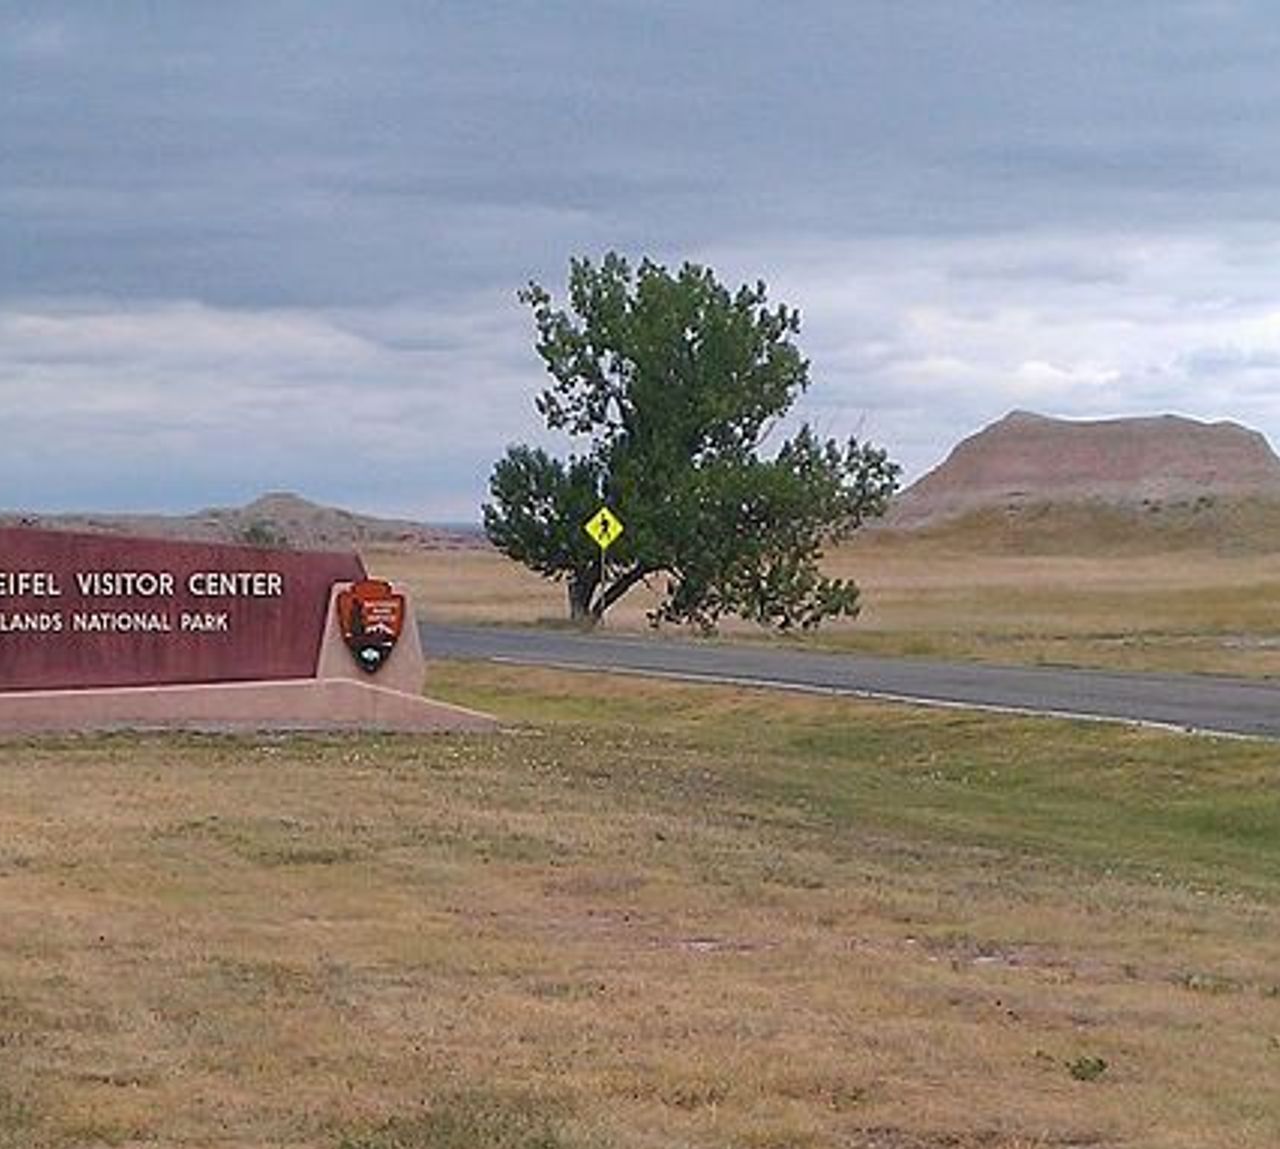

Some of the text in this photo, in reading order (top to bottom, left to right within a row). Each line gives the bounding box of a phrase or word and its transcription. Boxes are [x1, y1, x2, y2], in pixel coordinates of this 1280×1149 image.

[76, 572, 174, 596] VISITOR
[188, 572, 283, 596] CENTER
[72, 612, 171, 632] NATIONAL
[180, 612, 229, 632] PARK
